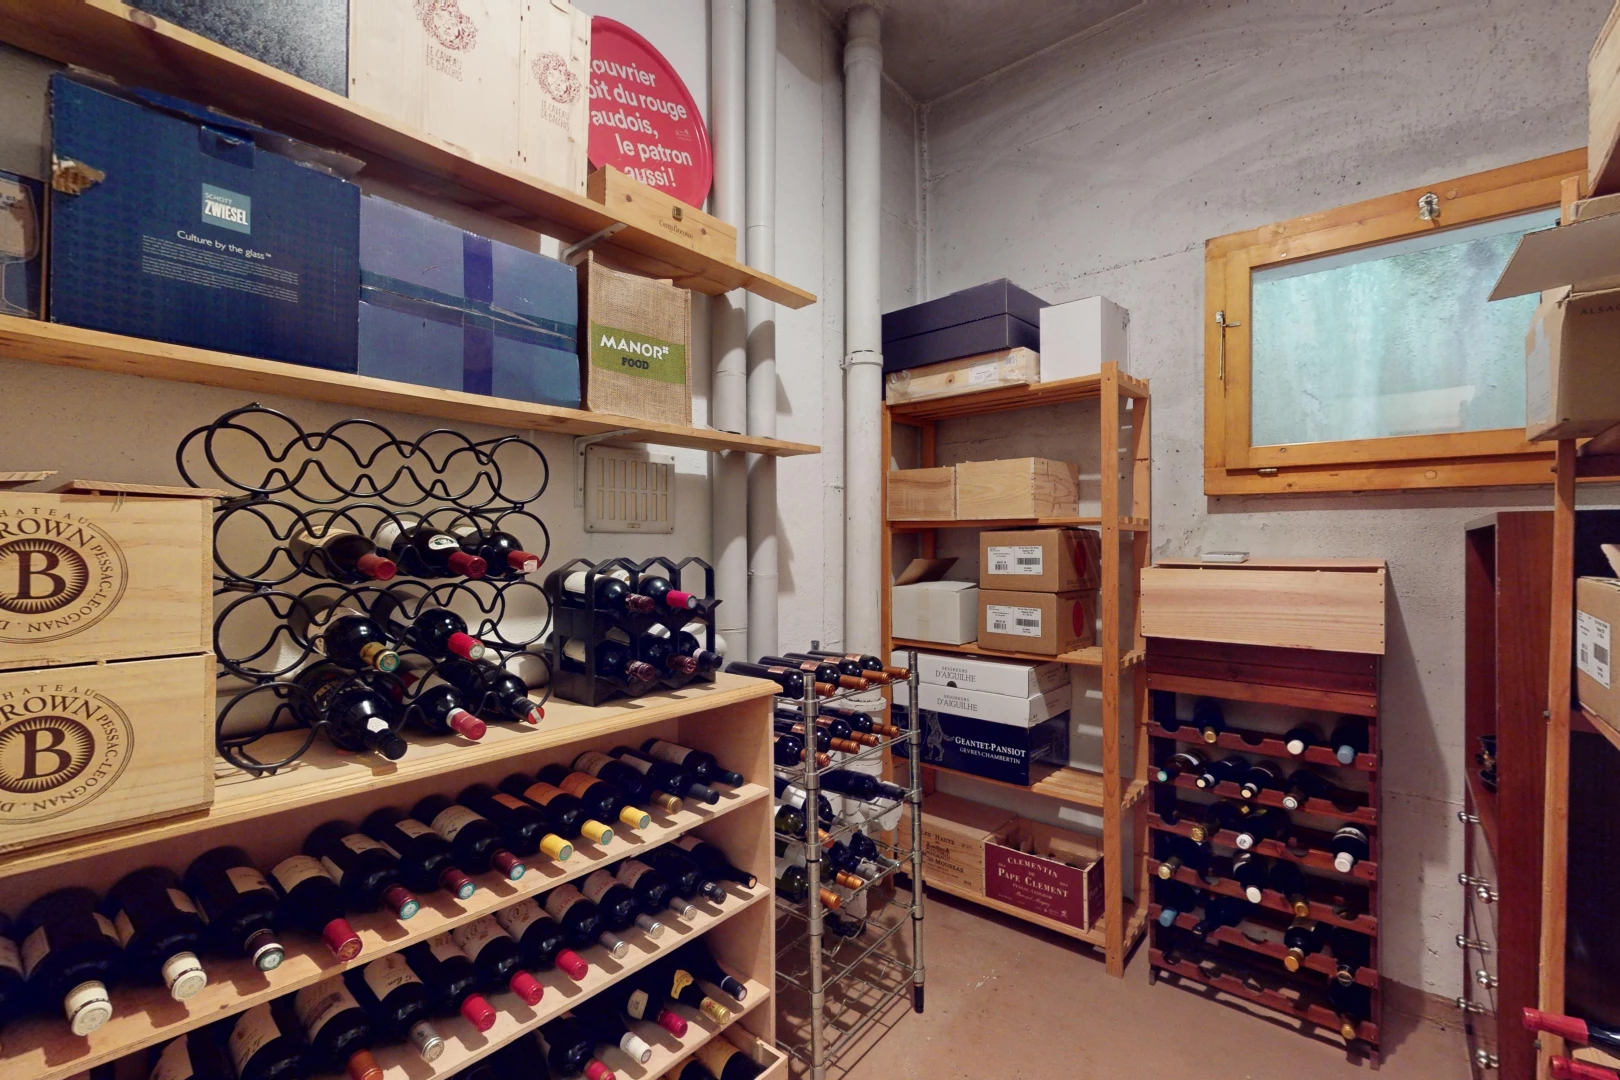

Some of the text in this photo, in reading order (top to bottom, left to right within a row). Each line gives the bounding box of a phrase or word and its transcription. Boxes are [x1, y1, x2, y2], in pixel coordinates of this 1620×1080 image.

[590, 59, 656, 87] ouvrier
[588, 79, 687, 121] oit du rouge
[590, 108, 659, 139] audois,
[615, 133, 693, 166] le patron
[204, 192, 233, 205] SCHOTT
[204, 199, 249, 225] ZWIESEL
[177, 230, 213, 247] Culture
[215, 239, 227, 252] by
[228, 244, 244, 254] the
[600, 334, 663, 360] MANOR
[621, 356, 650, 370] FOOD
[0, 507, 88, 525] HATEAU
[0, 518, 96, 549] ROWN
[13, 550, 67, 600] B
[935, 669, 977, 682] D'AIGUILHE
[941, 666, 968, 674] SEIGNEURS
[1, 684, 97, 701] HATEAU
[936, 697, 978, 712] D'AIGUILHE
[943, 694, 970, 702] SEIGNEURS
[0, 694, 103, 723] ROWN
[14, 726, 73, 782] B
[959, 747, 1021, 764] GEVREY-CHAMBERTIN
[1007, 857, 1058, 879] CLEMENTIN
[998, 867, 1021, 883] PAPE
[1025, 876, 1069, 898] CLEMENT
